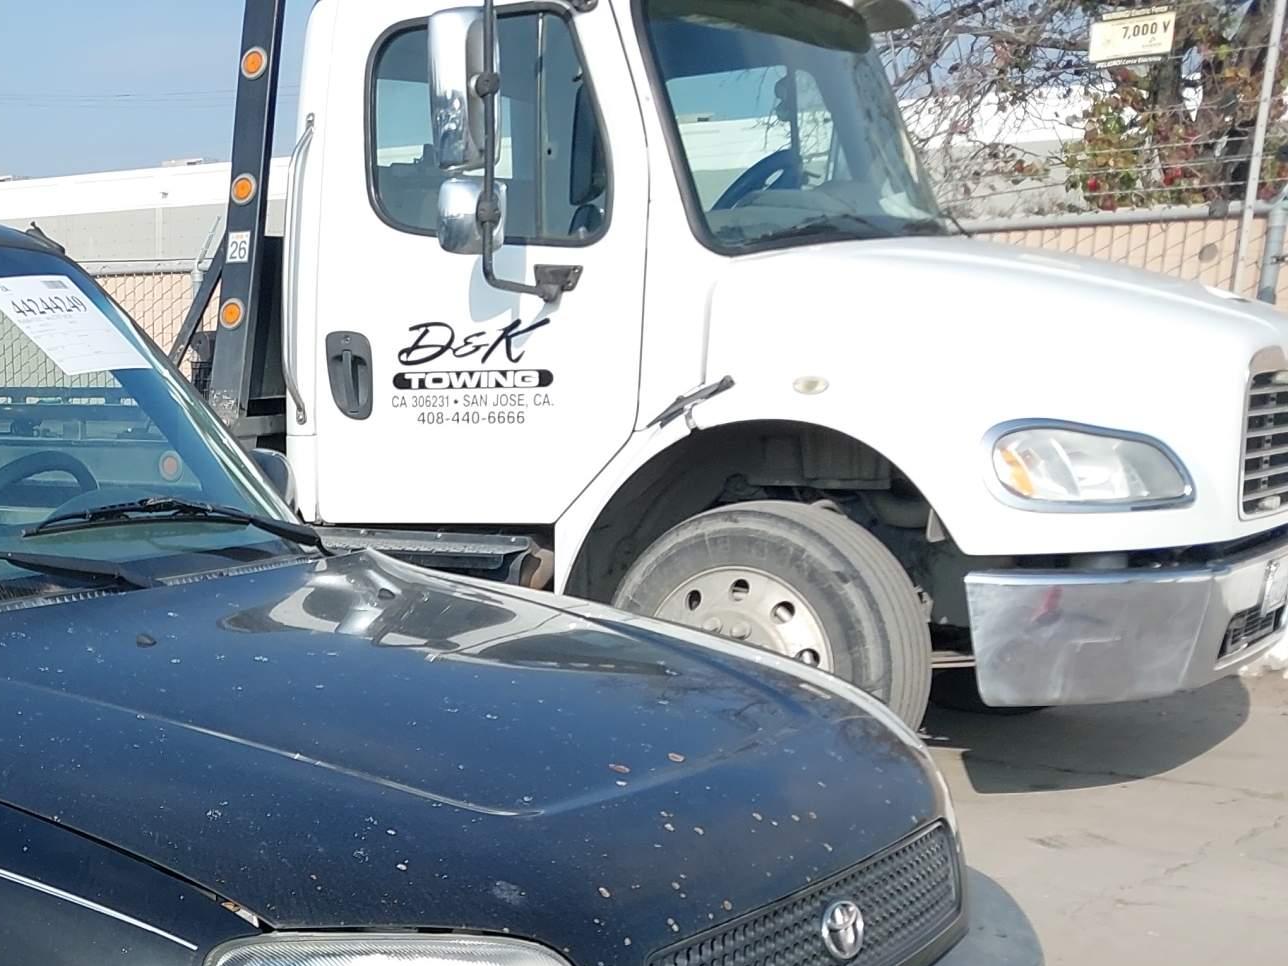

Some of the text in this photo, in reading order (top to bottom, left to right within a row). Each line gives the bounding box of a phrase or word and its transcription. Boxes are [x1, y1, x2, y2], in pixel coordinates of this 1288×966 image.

[1122, 22, 1158, 39] 7,000
[1163, 20, 1171, 33] V
[229, 240, 247, 259] 26
[12, 296, 87, 317] 44244249
[398, 318, 550, 365] D&K
[404, 370, 540, 389] TOWING
[392, 393, 554, 408] CA 306231 SAN JOSE, CA.
[417, 411, 525, 424] 408-440-6666
